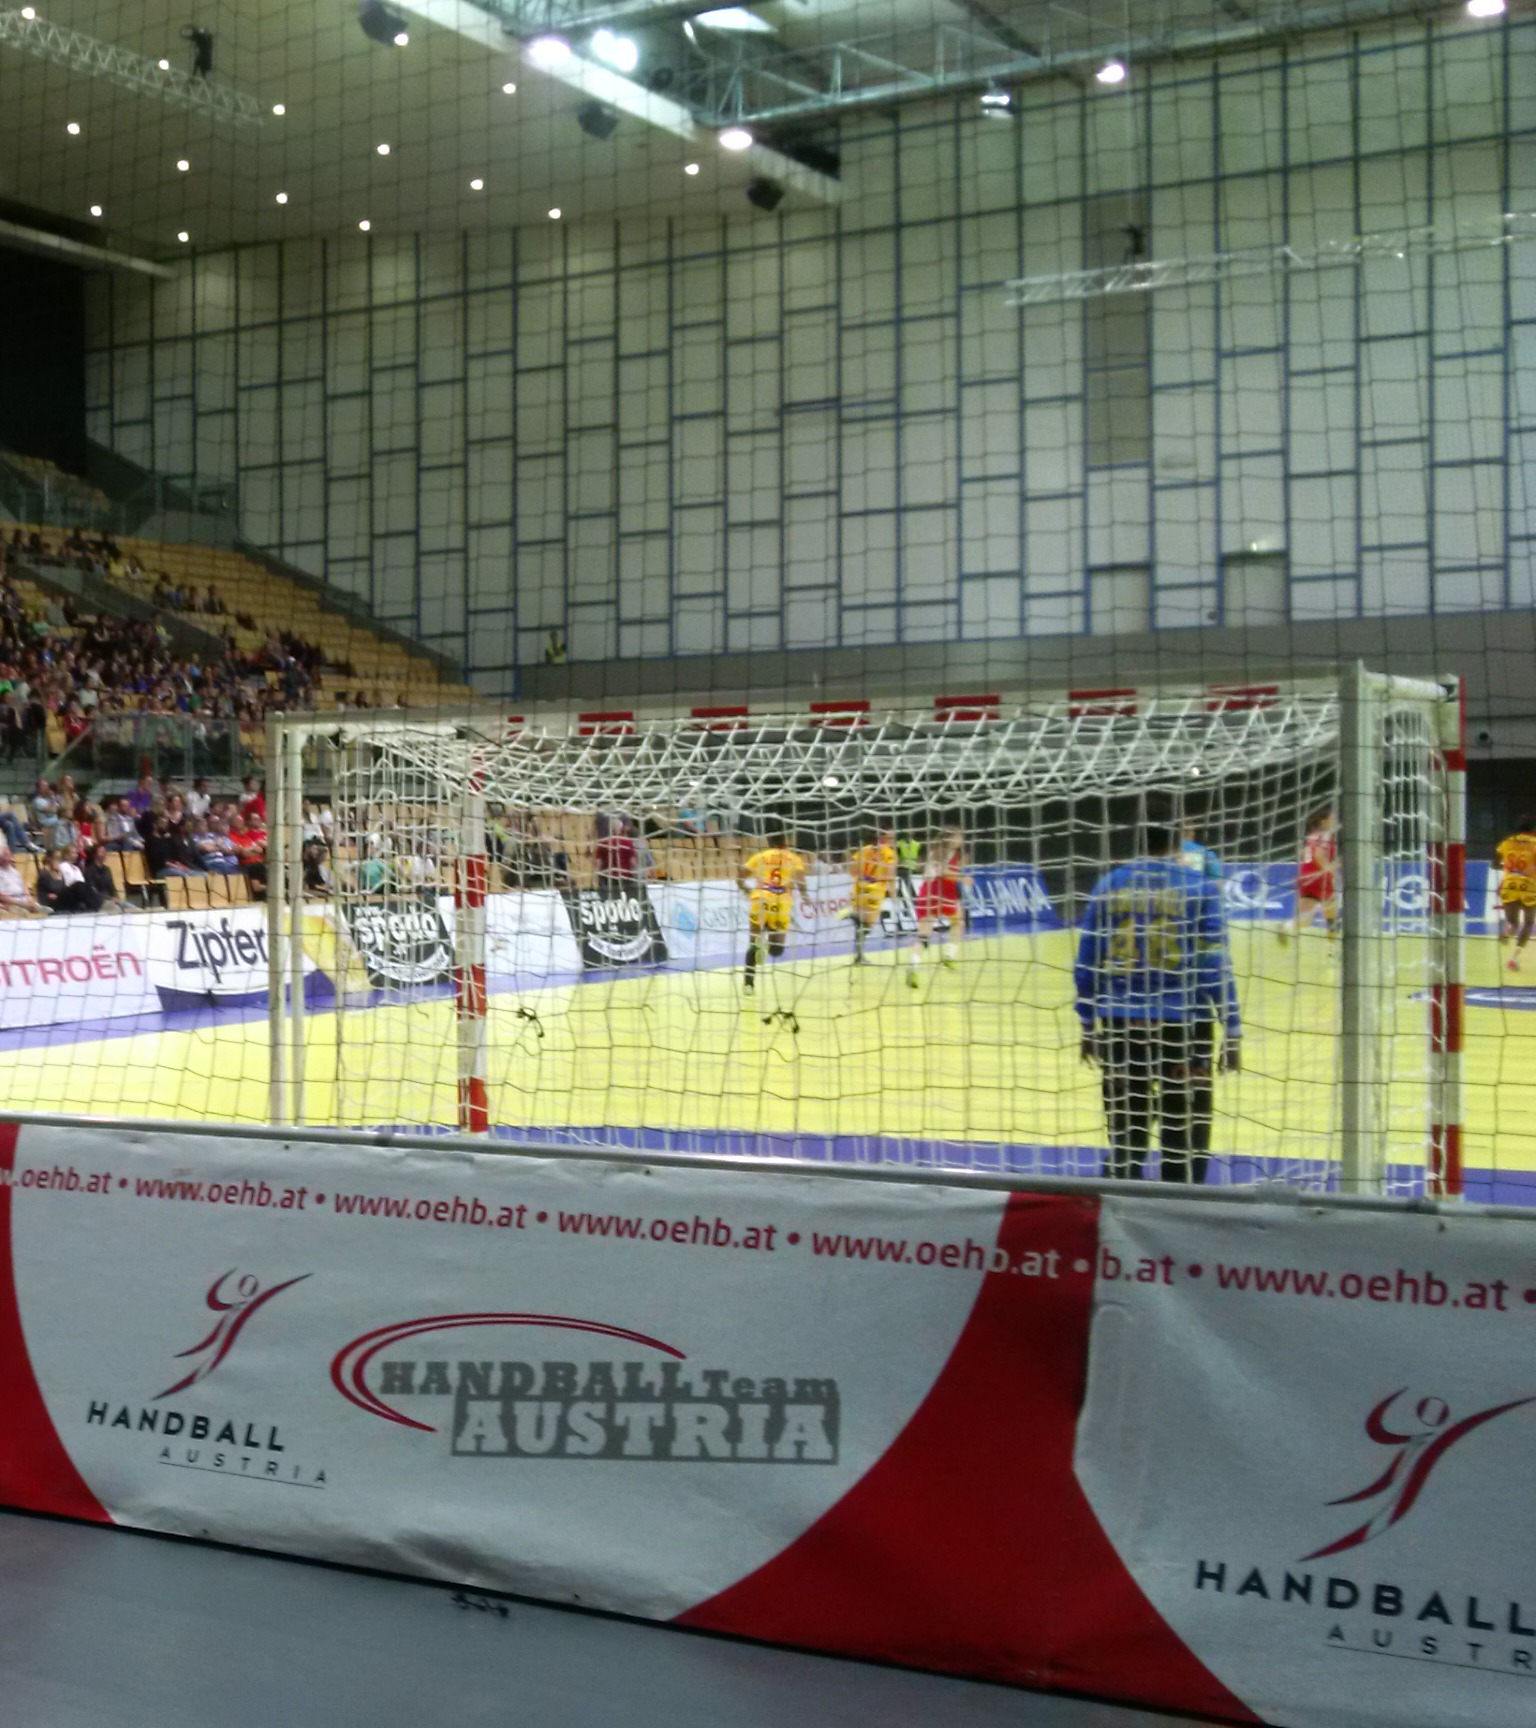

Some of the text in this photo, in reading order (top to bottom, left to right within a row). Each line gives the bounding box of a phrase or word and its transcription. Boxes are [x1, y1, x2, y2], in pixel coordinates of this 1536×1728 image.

[166, 917, 270, 983] Zipfer
[134, 1172, 306, 1210] www.oehb.at
[334, 1190, 527, 1230] www.oehb.at
[558, 1207, 777, 1253] www.oehb.at
[812, 1231, 1063, 1279] www.oehb.at
[1217, 1262, 1510, 1311] www.oehb.at
[380, 1360, 840, 1399] HANDBALL Team
[87, 1400, 286, 1452] HANDBALL
[454, 1398, 836, 1460] AUSTRIA
[160, 1446, 327, 1484] AUSTRIA
[1195, 1558, 1536, 1637] HANDBALL
